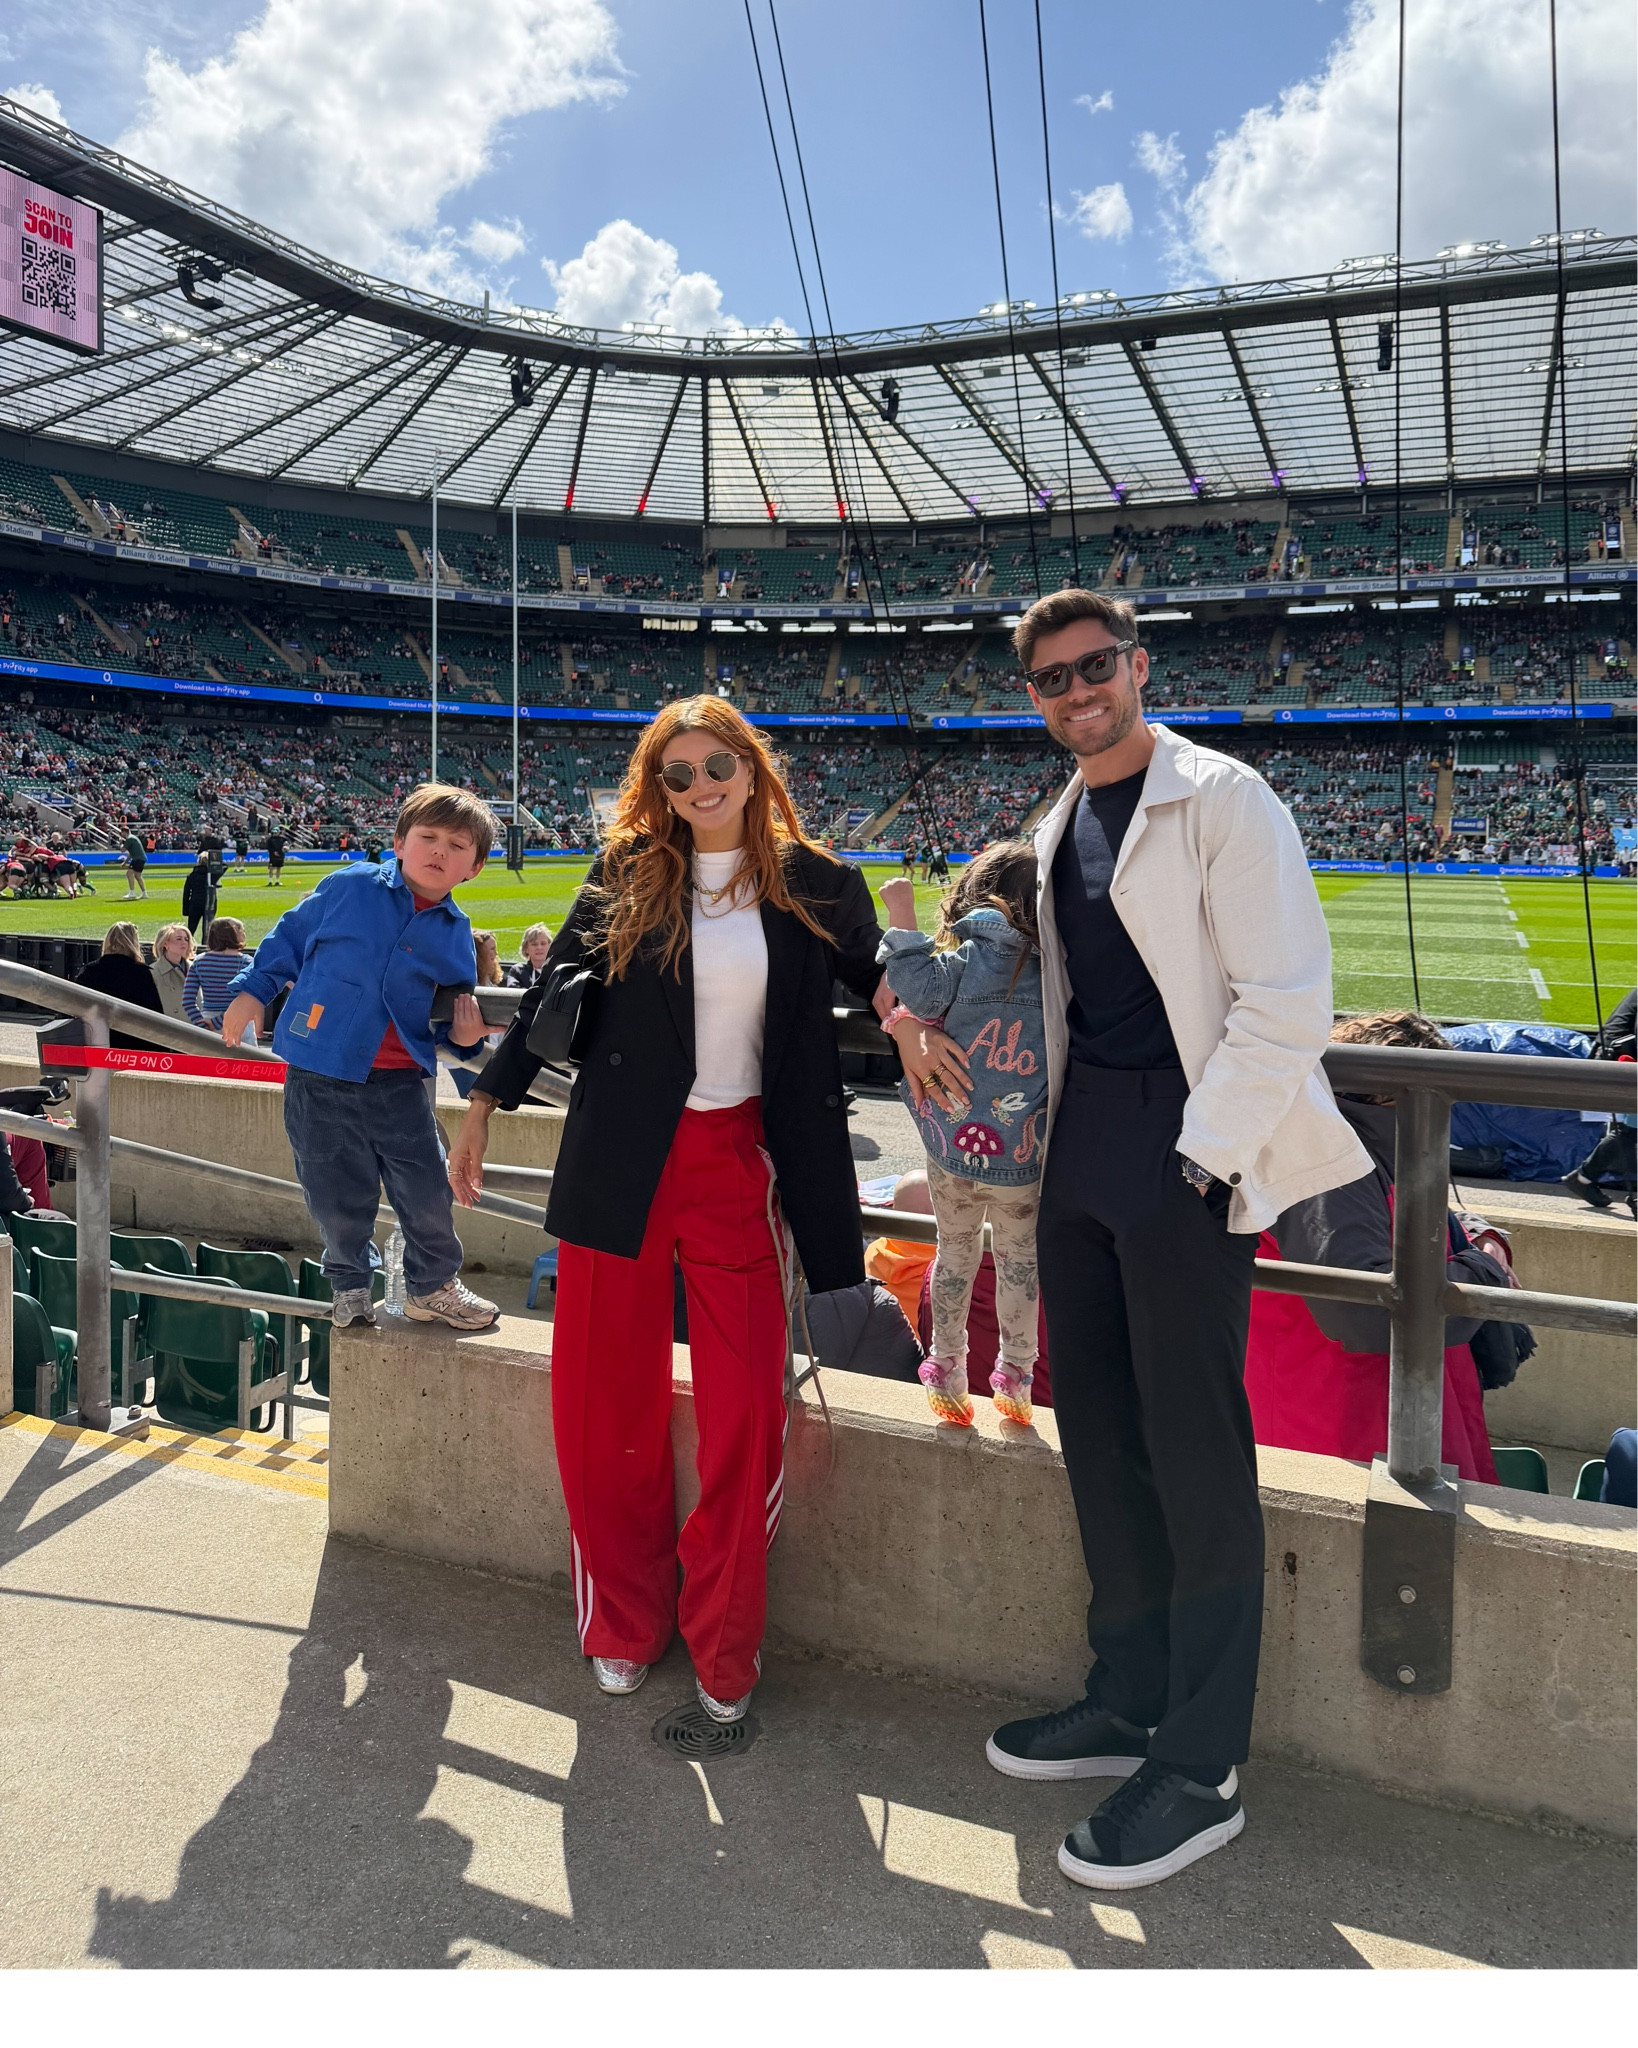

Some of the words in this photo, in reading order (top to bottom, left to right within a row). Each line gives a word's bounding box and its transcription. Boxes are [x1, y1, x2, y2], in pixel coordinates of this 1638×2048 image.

[24, 198, 56, 223] SCAN
[58, 212, 72, 229] TO
[24, 213, 73, 249] JOIN
[5, 524, 34, 537] Stadium
[63, 536, 86, 548] Allianz
[121, 548, 146, 558] Allianz
[157, 553, 186, 564] Stadium
[207, 561, 230, 572] Allianz
[261, 569, 283, 579] Allianz
[293, 574, 319, 584] Stadium
[1484, 576, 1512, 584] Allianz
[1524, 574, 1557, 583] Stadium
[1588, 571, 1616, 580] Allianz
[339, 580, 362, 589] Allianz
[1417, 579, 1443, 587] Allianz
[394, 586, 417, 595] Allianz
[1268, 587, 1292, 595] Allianz
[1334, 584, 1360, 592] Allianz
[471, 594, 492, 602] Allianz
[1209, 590, 1237, 598] Stadium
[520, 599, 541, 607] Allianz
[552, 600, 577, 608] Stadium
[672, 607, 698, 615] Stadium
[174, 683, 205, 692] Download
[388, 701, 417, 709] Download
[1326, 711, 1359, 719] Download
[1493, 708, 1527, 716] Download
[105, 1050, 137, 1066] Entry
[140, 1056, 157, 1068] No
